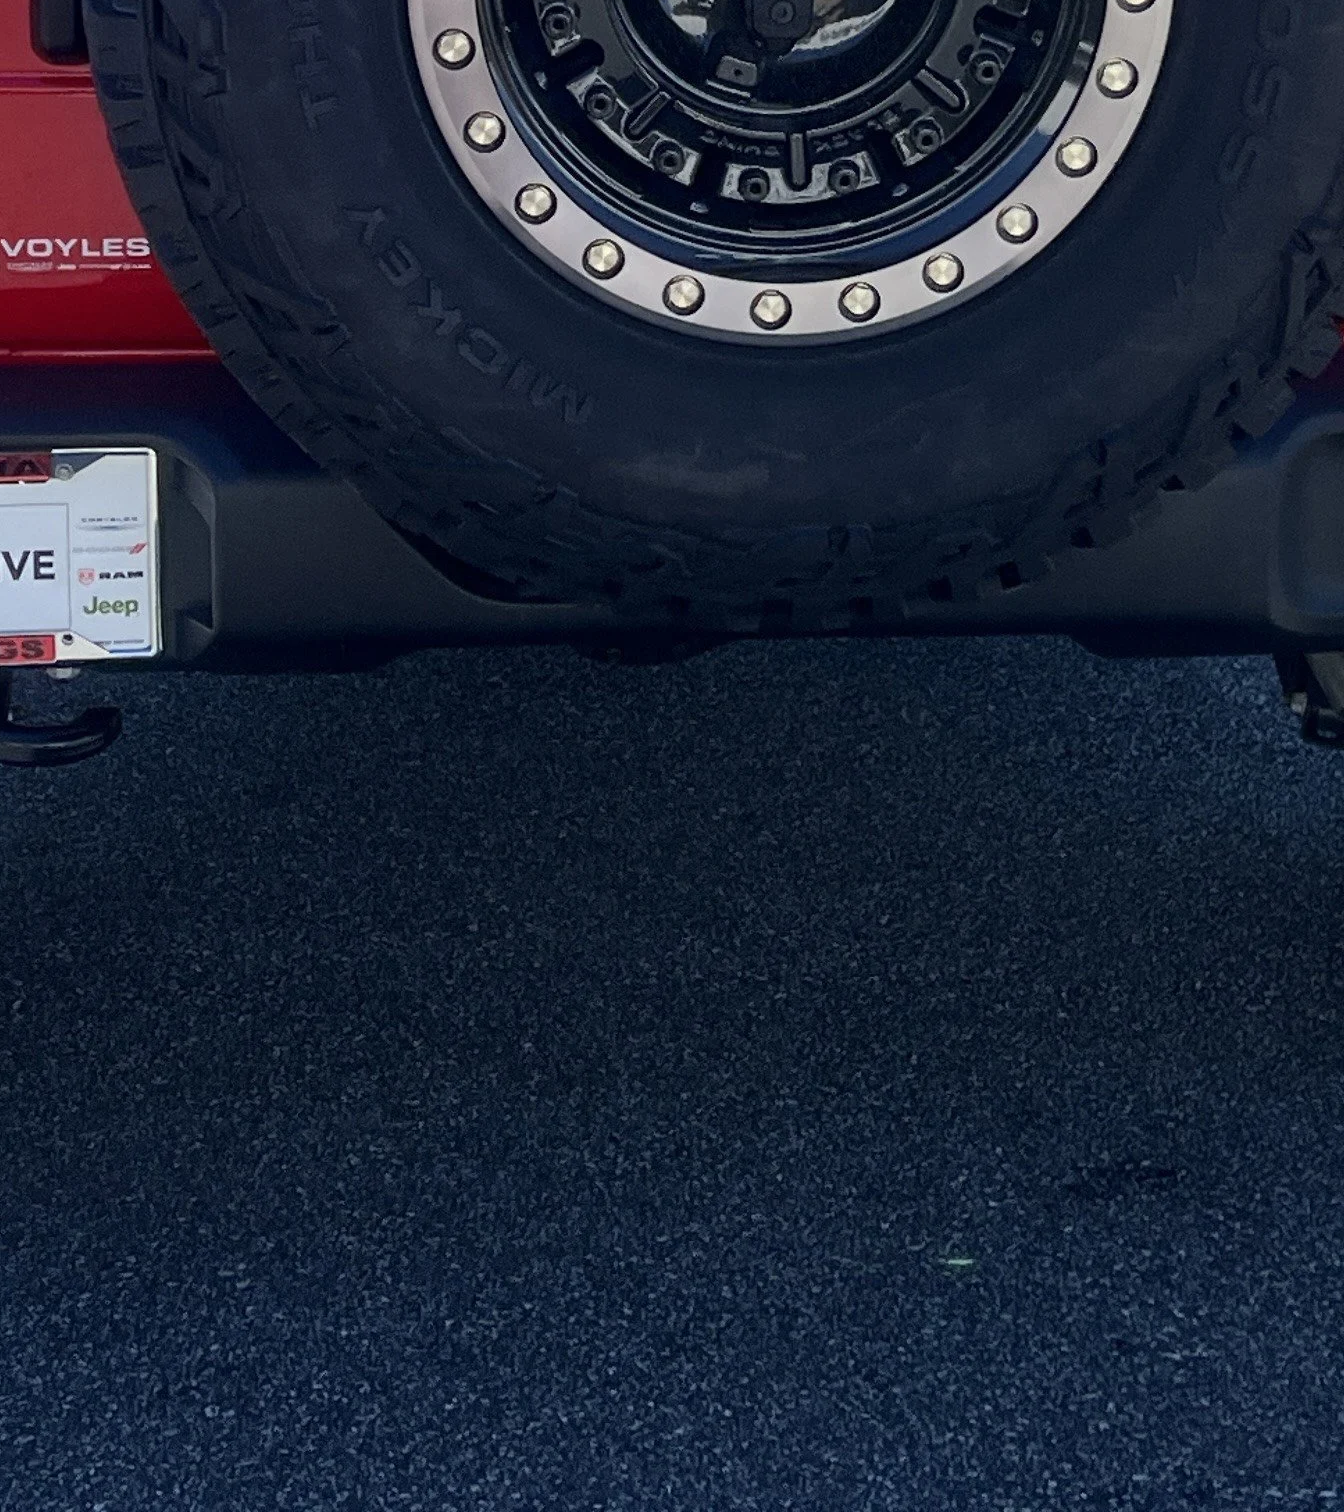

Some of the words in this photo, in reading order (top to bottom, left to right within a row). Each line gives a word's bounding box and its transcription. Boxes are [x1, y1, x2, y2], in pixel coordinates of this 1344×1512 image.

[0, 238, 151, 257] VOYLES
[344, 202, 596, 429] MICKEY
[83, 595, 139, 617] Jeep
